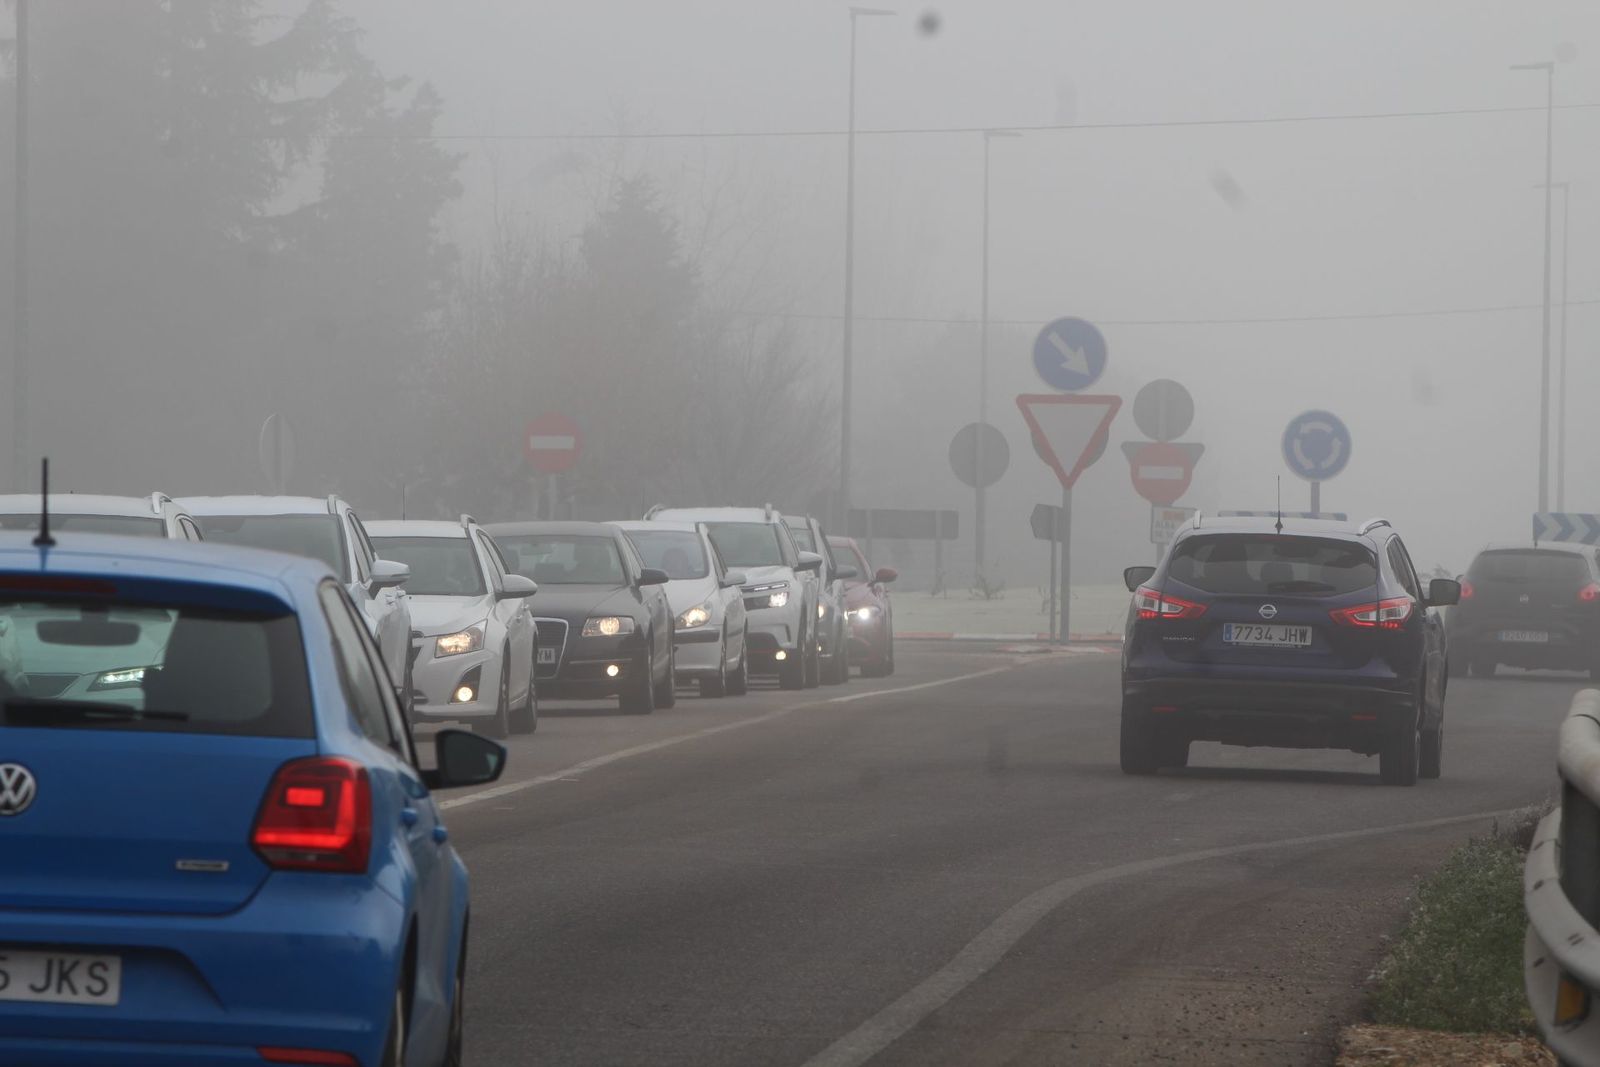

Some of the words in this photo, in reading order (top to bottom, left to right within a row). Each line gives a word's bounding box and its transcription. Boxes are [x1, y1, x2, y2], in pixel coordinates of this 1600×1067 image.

[1235, 626, 1273, 641] 7734
[1279, 627, 1308, 643] JHW
[28, 958, 109, 998] JKS
